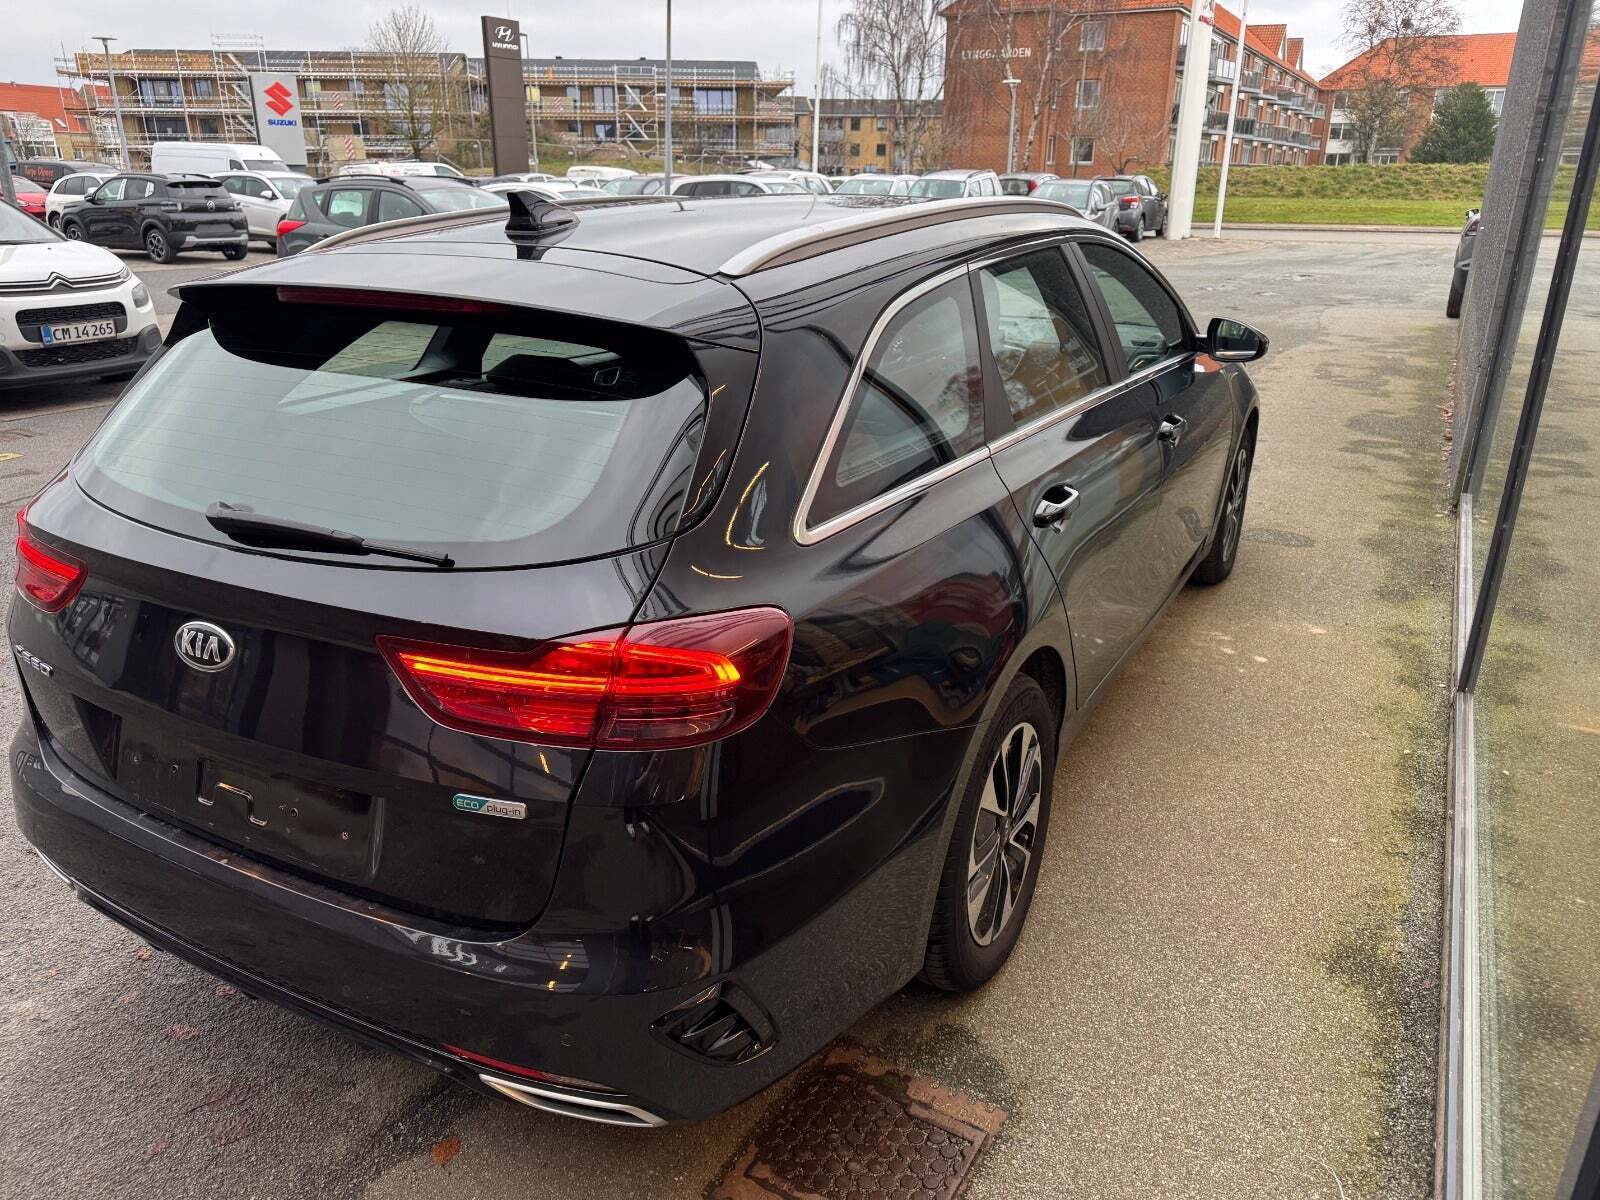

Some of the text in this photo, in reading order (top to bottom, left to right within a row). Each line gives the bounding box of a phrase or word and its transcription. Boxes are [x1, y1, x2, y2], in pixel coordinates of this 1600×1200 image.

[52, 322, 114, 341] CM 14 265
[181, 627, 221, 663] KIA
[456, 798, 521, 816] ECO plug-in
